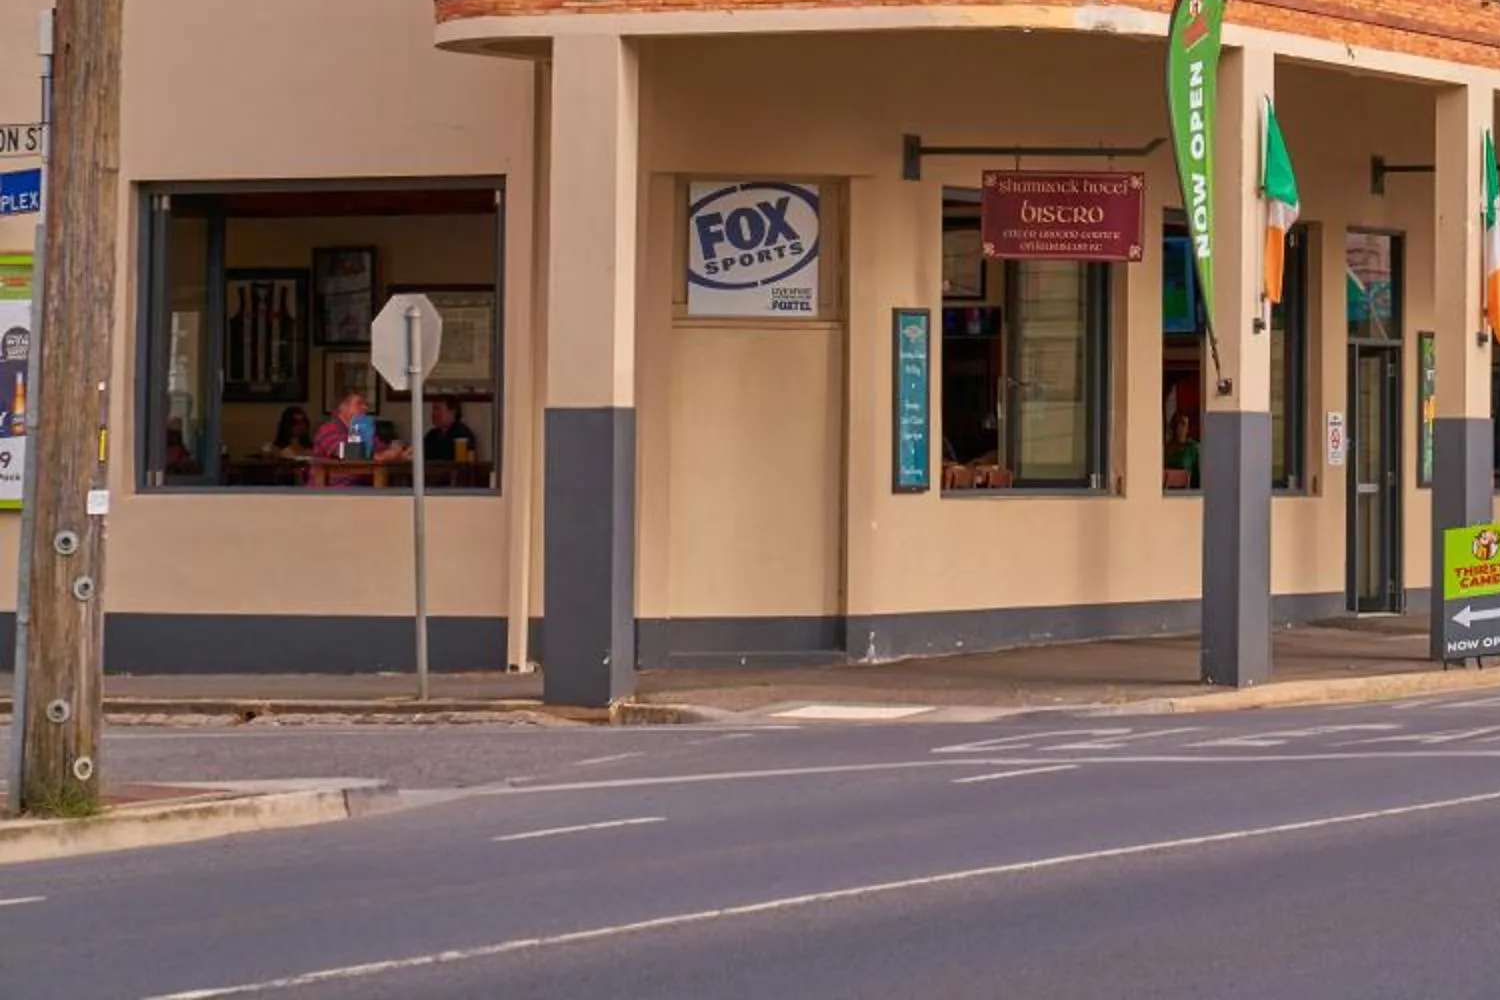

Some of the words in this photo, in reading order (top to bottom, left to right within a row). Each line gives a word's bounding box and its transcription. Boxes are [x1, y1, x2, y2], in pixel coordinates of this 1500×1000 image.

[1189, 60, 1205, 161] OPEN
[695, 196, 801, 261] FOX
[1191, 172, 1211, 259] NOW
[704, 241, 805, 275] SPORTS
[1447, 640, 1479, 653] NOW
